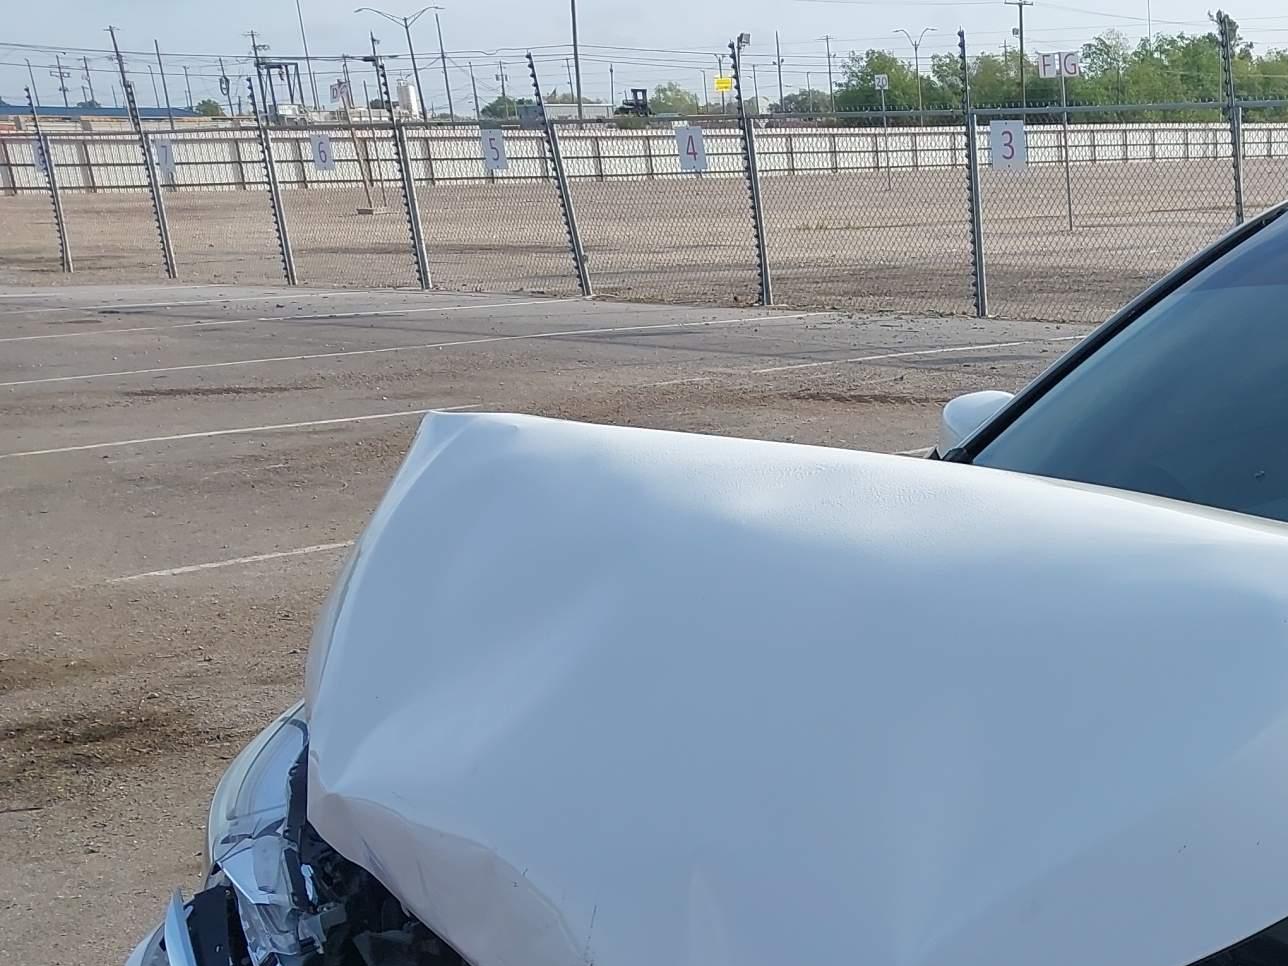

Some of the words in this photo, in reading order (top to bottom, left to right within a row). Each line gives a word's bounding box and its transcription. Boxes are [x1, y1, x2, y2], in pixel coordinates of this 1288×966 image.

[1041, 54, 1052, 77] F
[1063, 53, 1077, 75] G
[318, 141, 327, 163] 6
[488, 138, 500, 161] 5
[686, 135, 698, 161] 4
[1001, 130, 1015, 160] 3
